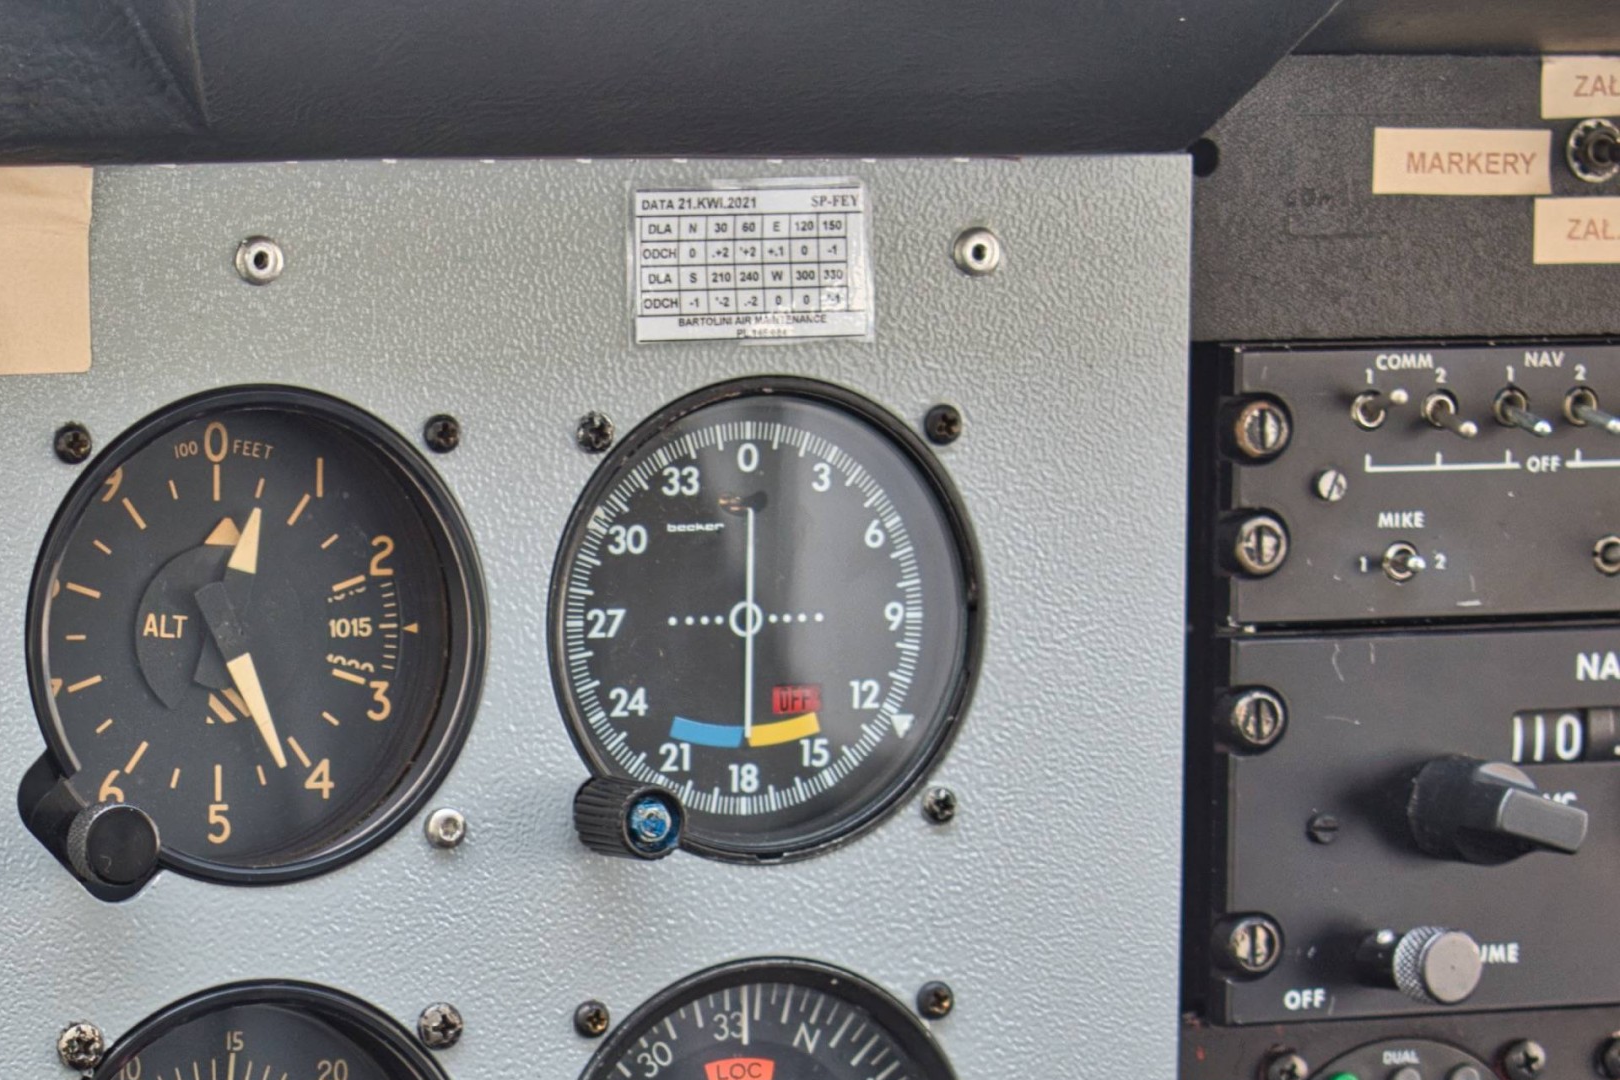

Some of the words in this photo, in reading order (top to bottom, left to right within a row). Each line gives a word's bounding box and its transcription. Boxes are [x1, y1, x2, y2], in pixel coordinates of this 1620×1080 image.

[1406, 151, 1537, 175] MARKERY
[641, 200, 675, 210] DATA
[811, 194, 859, 207] SP-FEY
[648, 224, 672, 234] DLA
[689, 224, 696, 232] N
[714, 223, 727, 232] 30
[742, 222, 755, 232] 60
[773, 222, 780, 232] E
[795, 221, 814, 231] 120
[823, 221, 842, 230] 150
[642, 249, 676, 259] ODCH
[648, 274, 672, 284] DLA
[690, 273, 697, 283] S
[712, 272, 731, 282] 210
[740, 272, 759, 281] 240
[771, 271, 782, 280] W
[796, 270, 815, 280] 300
[824, 270, 843, 280] 330
[644, 298, 678, 309] ODCH
[679, 318, 732, 327] BARTOLINI
[735, 316, 751, 325] AIR
[1375, 354, 1434, 370] COMM
[1524, 351, 1564, 368] NAV
[1365, 369, 1373, 384] 1
[1435, 367, 1447, 383] 2
[1506, 366, 1513, 382] 1
[1574, 365, 1586, 381] 2
[175, 441, 198, 458] 100
[204, 422, 228, 464] 0
[233, 442, 274, 460] FEET
[737, 443, 759, 472] 0
[1526, 455, 1561, 473] OFF
[662, 467, 700, 496] 33
[812, 463, 831, 492] 3
[666, 523, 724, 532] becker
[1377, 511, 1425, 528] MIKE
[608, 525, 647, 554] 30
[865, 520, 885, 548] 6
[370, 535, 394, 576] 2
[1359, 557, 1368, 571] 1
[1434, 554, 1447, 569] 2
[143, 614, 187, 639] ALT
[586, 609, 626, 639] 27
[885, 602, 904, 631] 9
[329, 618, 372, 638] 1015
[367, 681, 391, 721] 3
[609, 687, 648, 717] 24
[849, 681, 879, 709] 12
[659, 743, 690, 772] 21
[800, 739, 830, 766] 15
[305, 758, 335, 798] 4
[729, 765, 758, 794] 18
[208, 804, 230, 843] 5
[1284, 989, 1325, 1010] OFF
[713, 1011, 744, 1040] 33
[226, 1032, 244, 1051] 15
[793, 1023, 822, 1054] N
[637, 1040, 673, 1077] 30
[1383, 1050, 1419, 1065] DUAL
[716, 1062, 762, 1079] LOC
